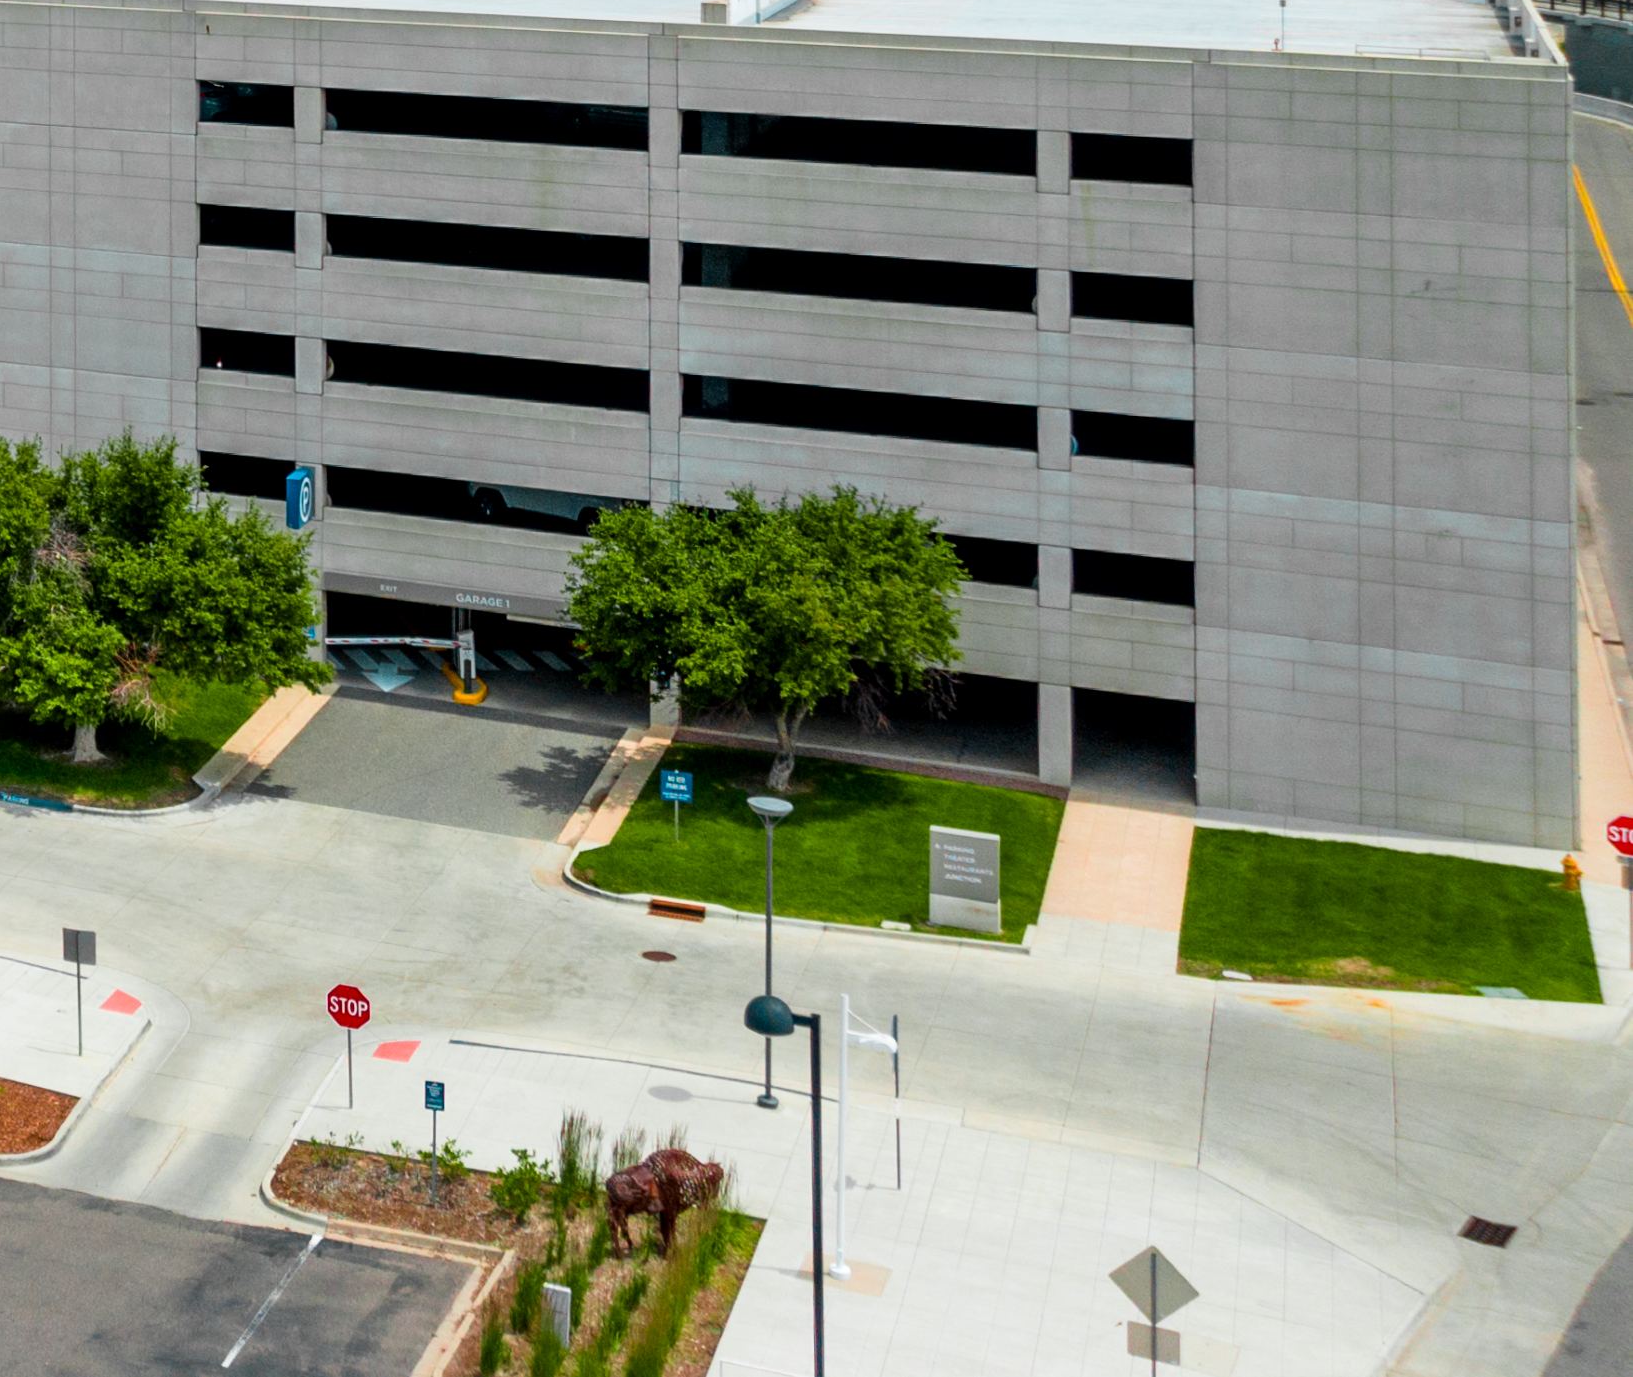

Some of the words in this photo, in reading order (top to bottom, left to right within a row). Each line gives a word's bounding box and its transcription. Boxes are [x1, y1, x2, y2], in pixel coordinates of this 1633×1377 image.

[380, 584, 398, 593] EXIT
[455, 593, 504, 607] GARAGE
[505, 599, 510, 609] 1
[330, 996, 368, 1017] STOP
